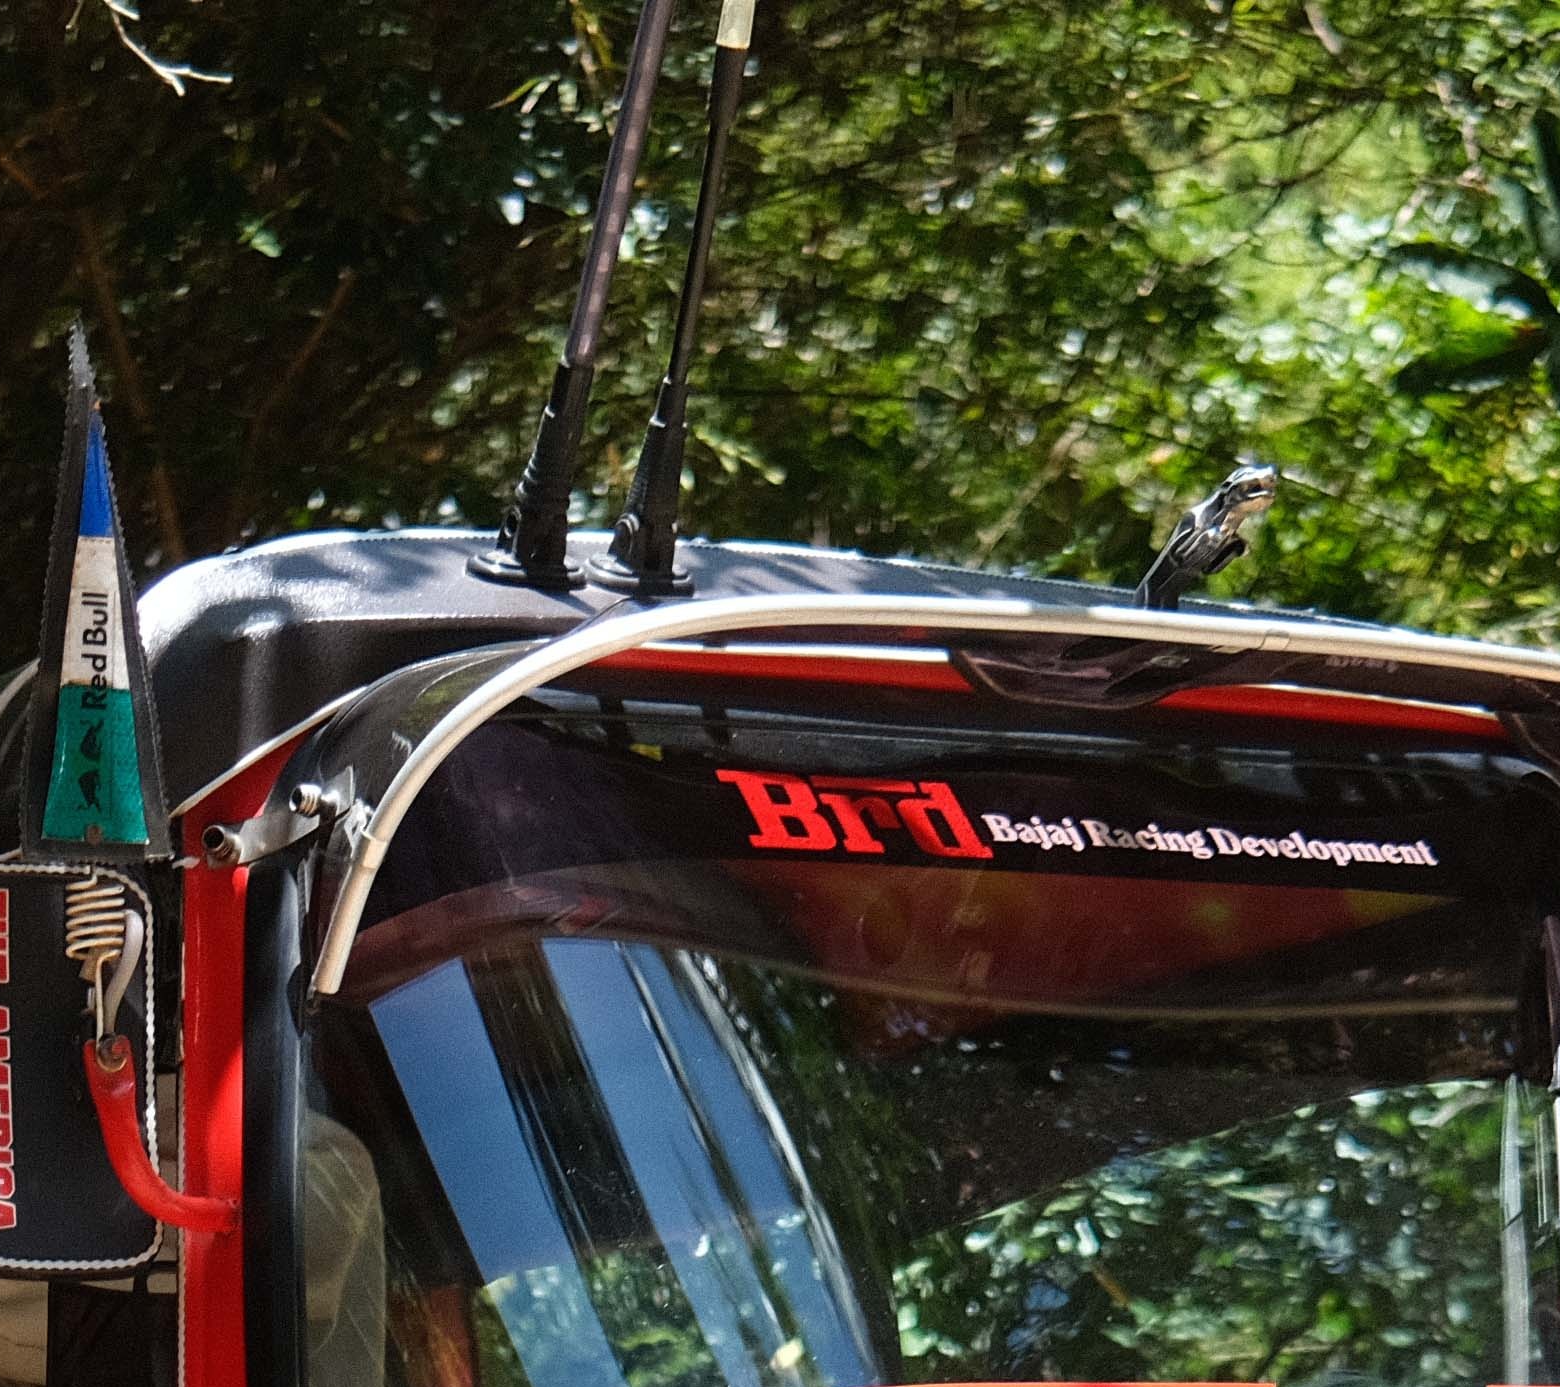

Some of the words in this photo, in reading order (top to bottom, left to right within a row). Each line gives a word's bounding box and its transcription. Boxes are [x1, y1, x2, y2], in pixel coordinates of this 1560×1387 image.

[81, 591, 109, 647] Bull
[81, 653, 109, 711] Red
[716, 768, 994, 860] Brd
[981, 812, 1083, 853] Bajaj
[1080, 819, 1215, 860] Racing
[1208, 826, 1440, 868] Development
